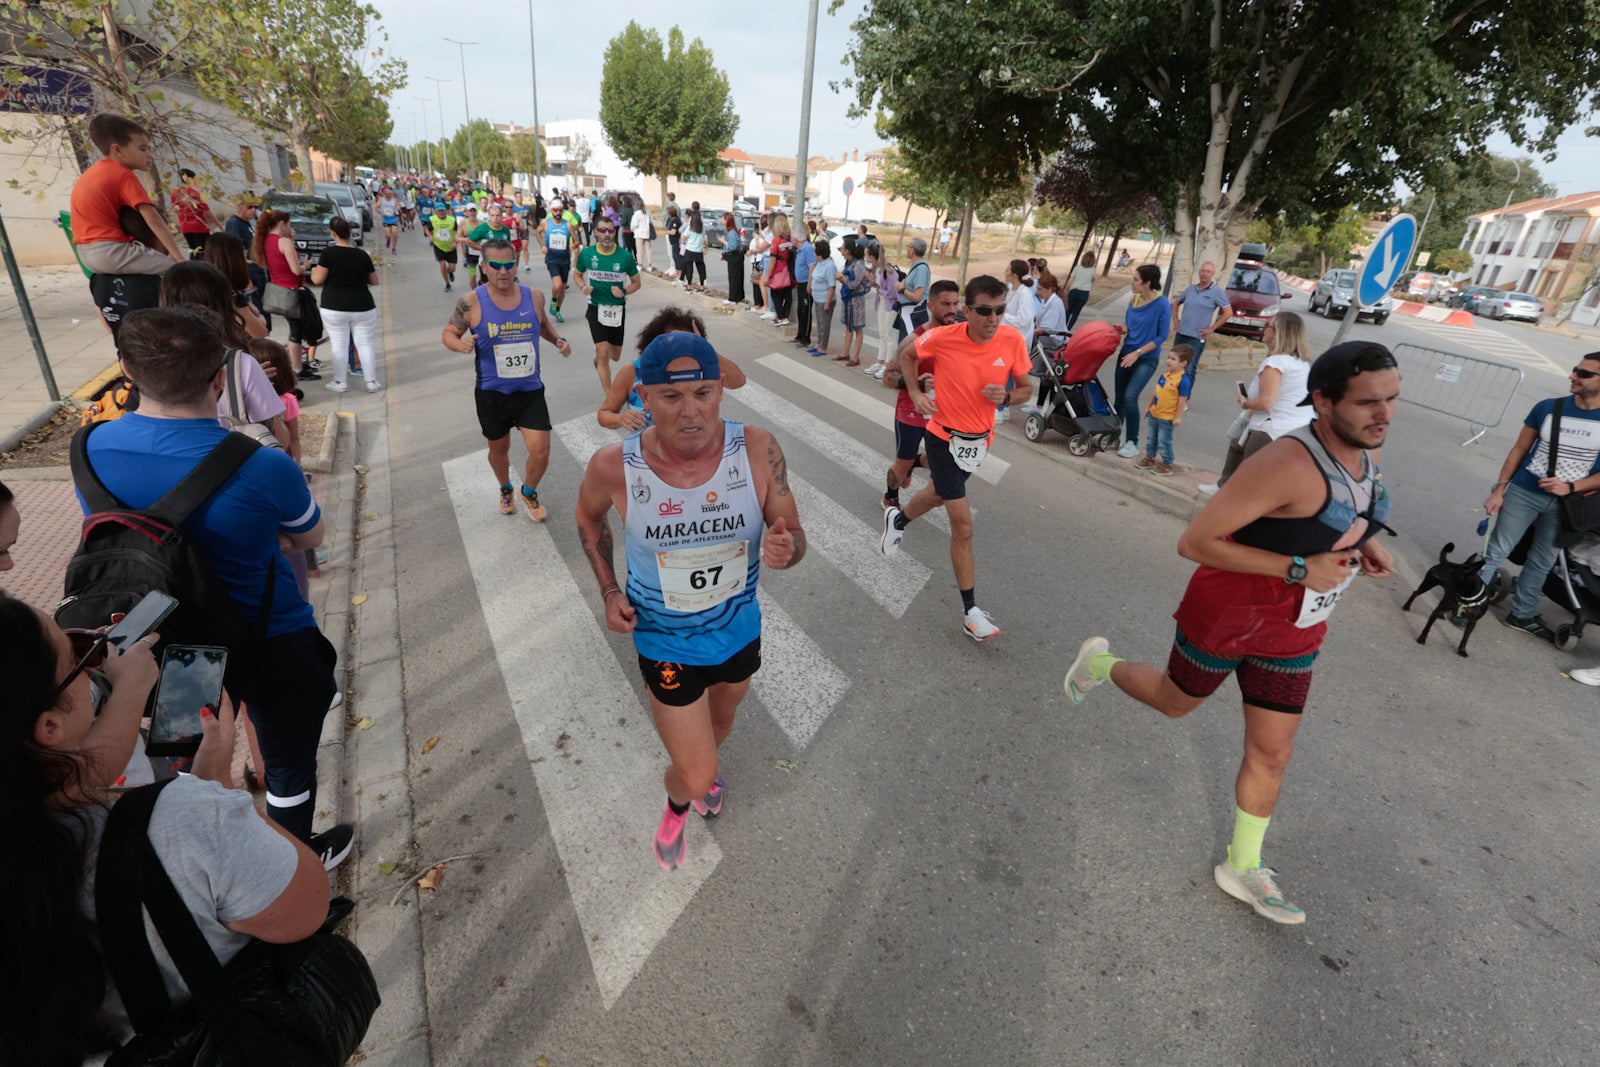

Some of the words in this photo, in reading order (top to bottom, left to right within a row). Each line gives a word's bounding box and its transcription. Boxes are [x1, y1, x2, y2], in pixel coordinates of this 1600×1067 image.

[603, 310, 617, 319] 581
[501, 321, 532, 330] olimpo
[505, 354, 528, 367] 337
[957, 446, 978, 459] 293
[702, 503, 730, 513] mayfo
[645, 514, 745, 539] MARACENA
[692, 532, 736, 543] ATLETISMO
[689, 565, 723, 590] 67
